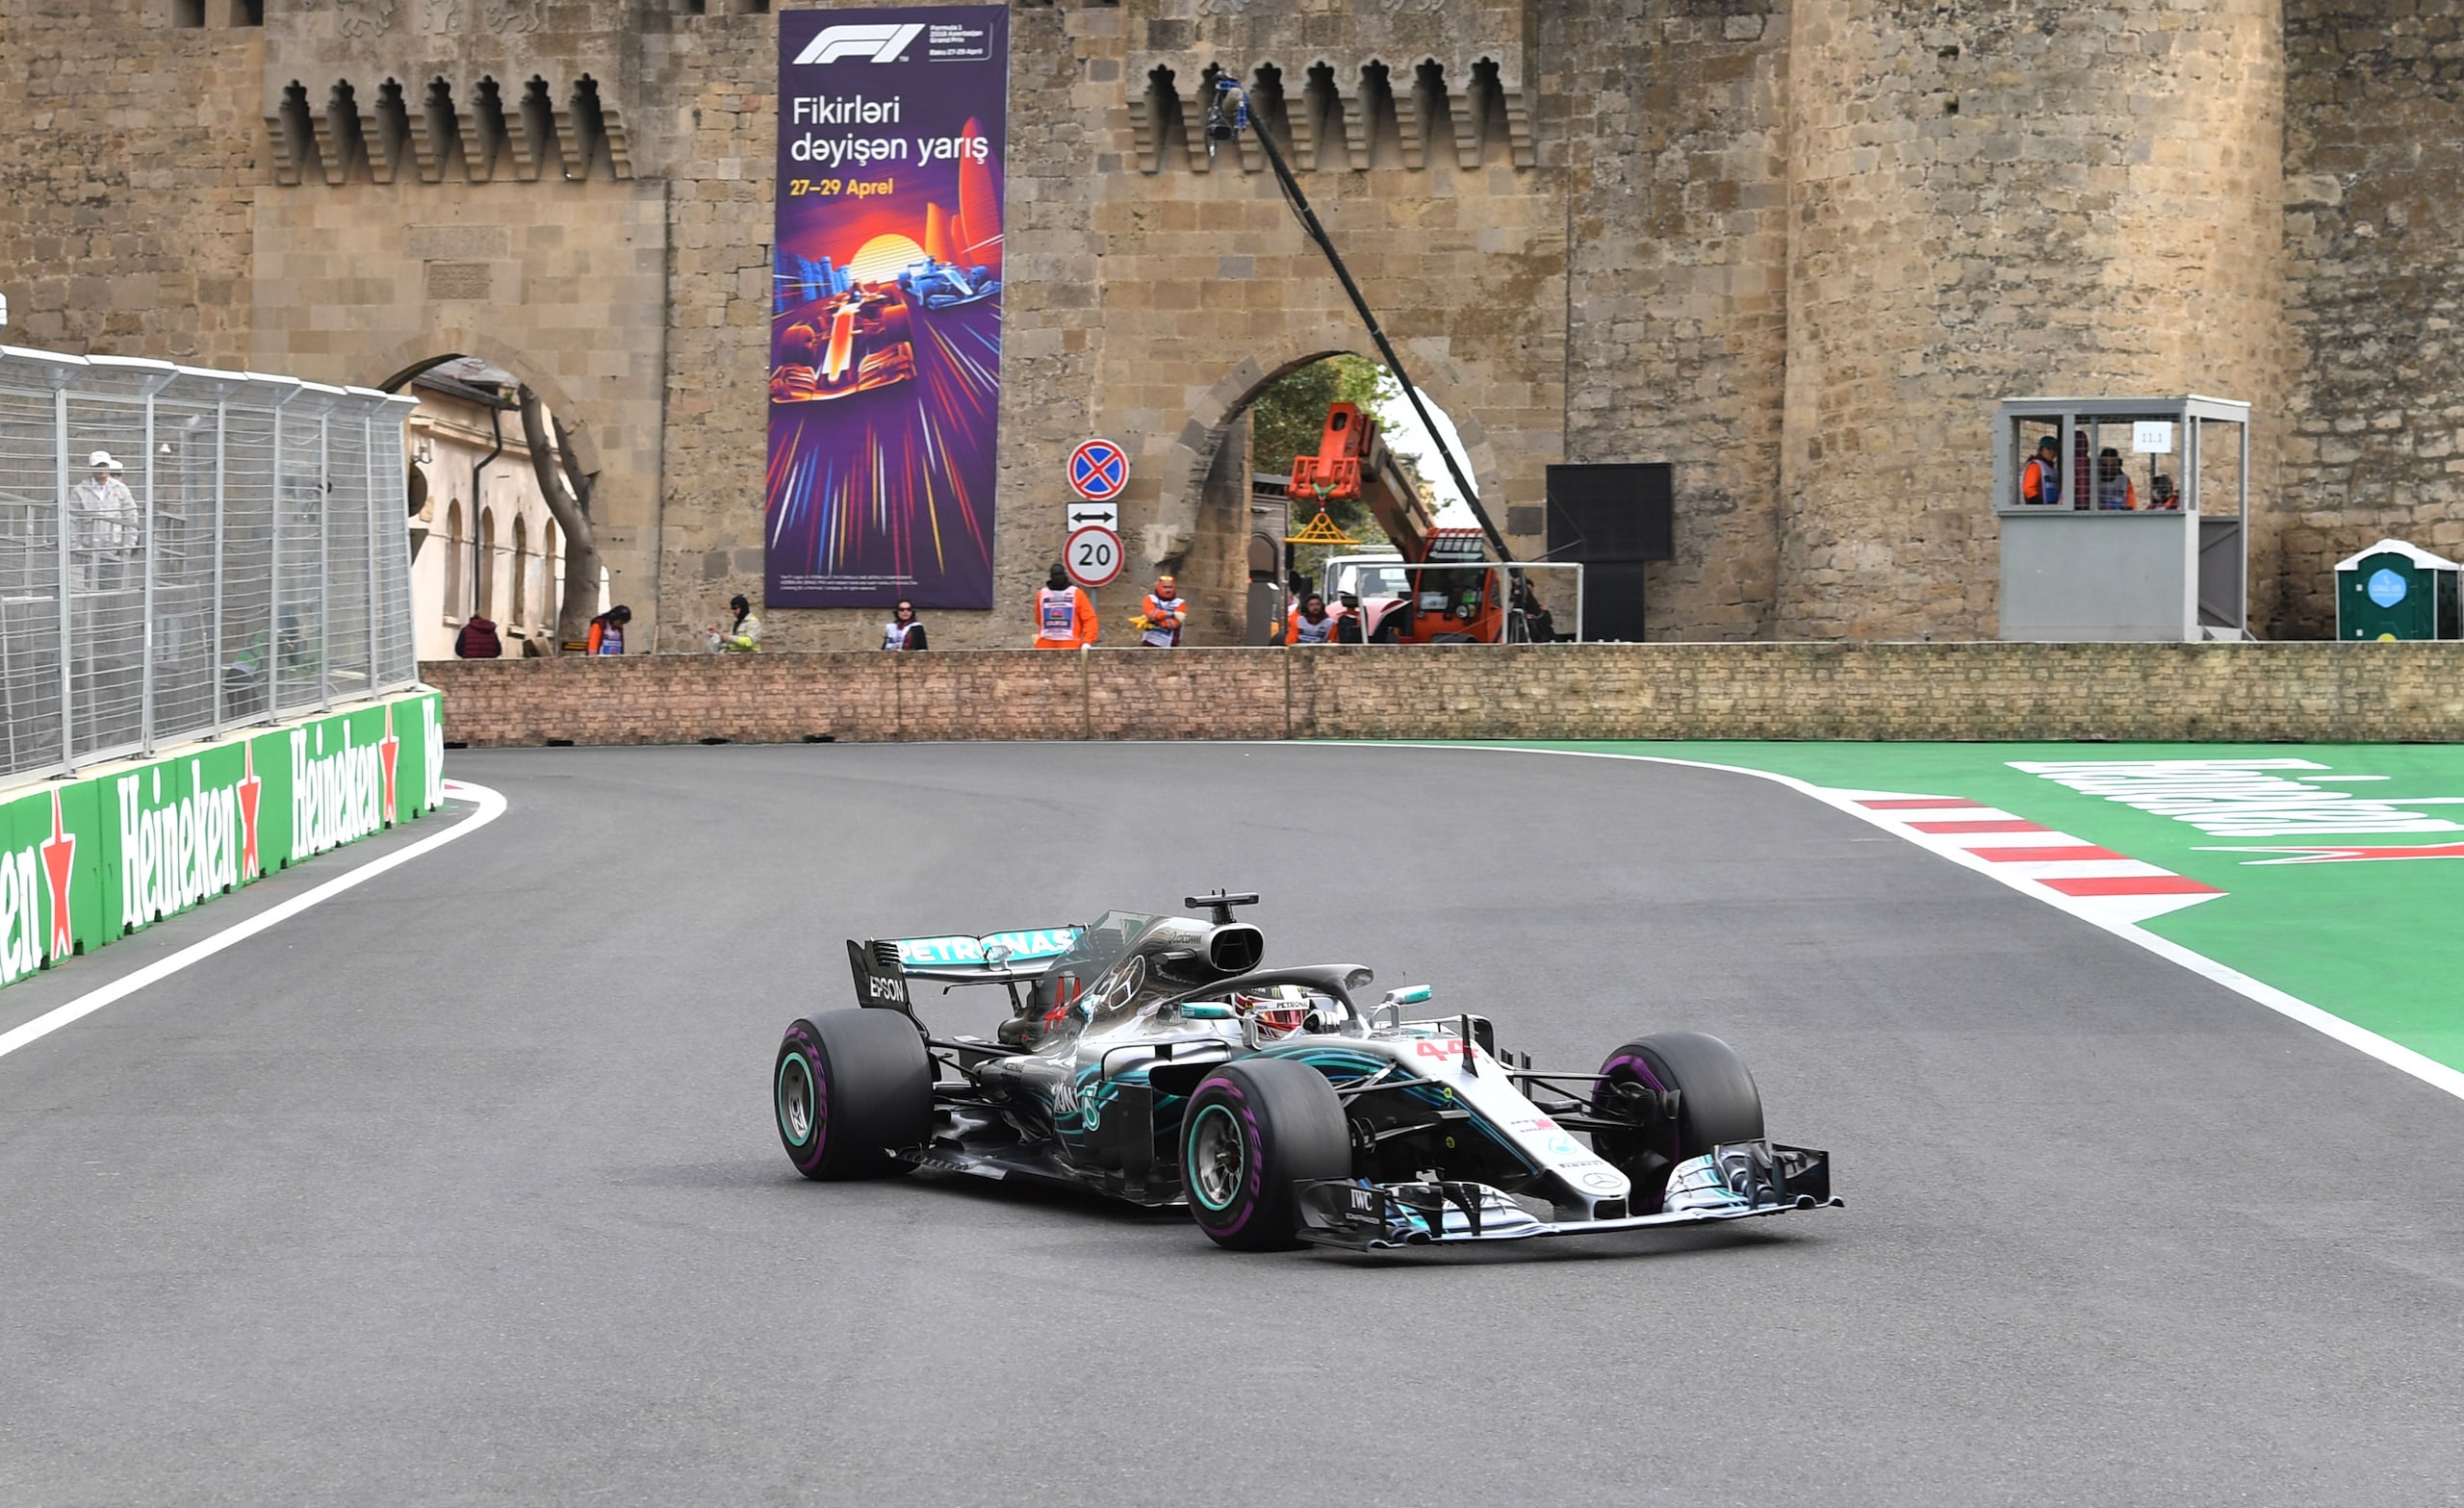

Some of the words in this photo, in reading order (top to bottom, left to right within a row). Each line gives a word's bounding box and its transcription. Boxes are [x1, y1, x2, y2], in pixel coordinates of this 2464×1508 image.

[793, 23, 926, 64] F1
[793, 94, 900, 124] Fikirləri
[791, 132, 908, 167] dəyişən
[916, 136, 988, 166] yarış
[845, 178, 893, 199] Aprel
[1079, 544, 1111, 566] 20
[290, 719, 381, 859] Heineken
[116, 758, 238, 927] Heineken
[0, 846, 42, 985] en
[870, 975, 904, 1002] EPSON
[1417, 1039, 1479, 1061] 44
[1350, 1189, 1373, 1212] IWC
